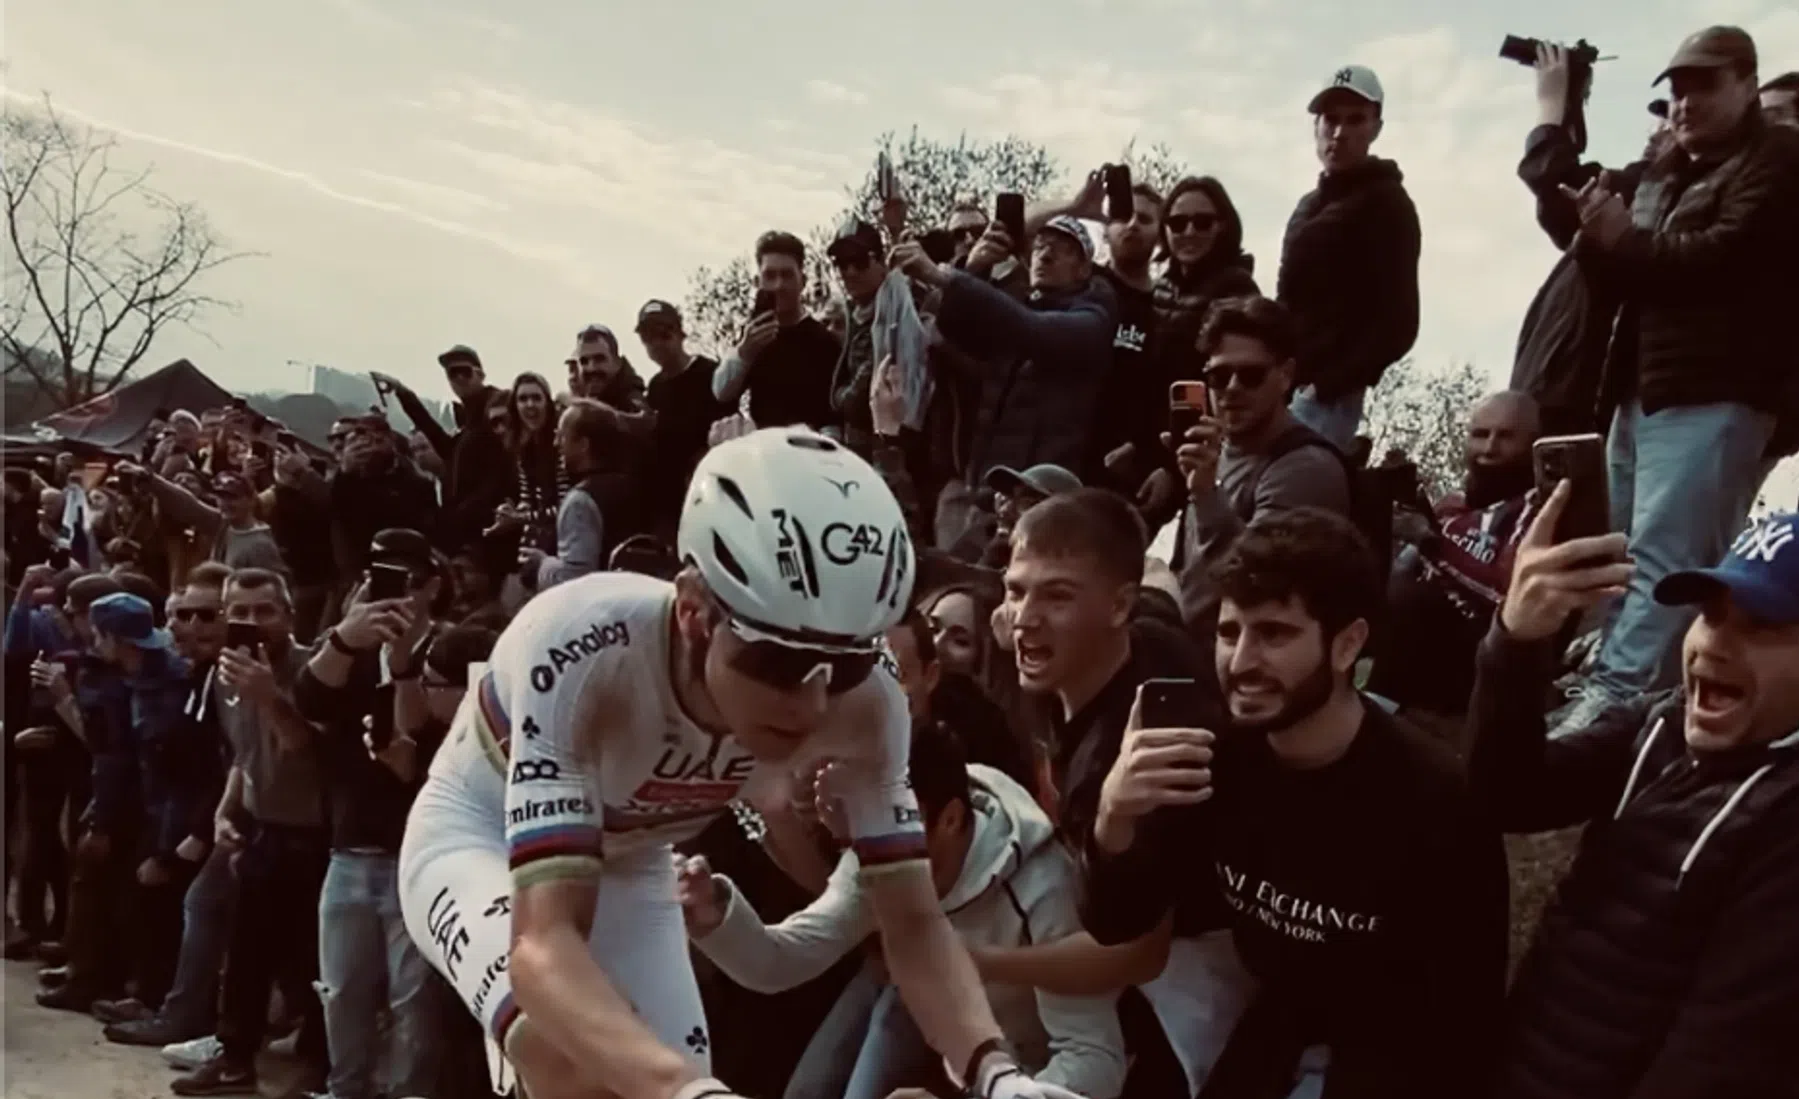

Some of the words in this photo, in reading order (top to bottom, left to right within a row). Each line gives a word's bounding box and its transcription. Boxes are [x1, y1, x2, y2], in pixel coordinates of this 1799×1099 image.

[820, 521, 884, 566] G42
[652, 747, 756, 781] UAE
[506, 796, 595, 828] mirates
